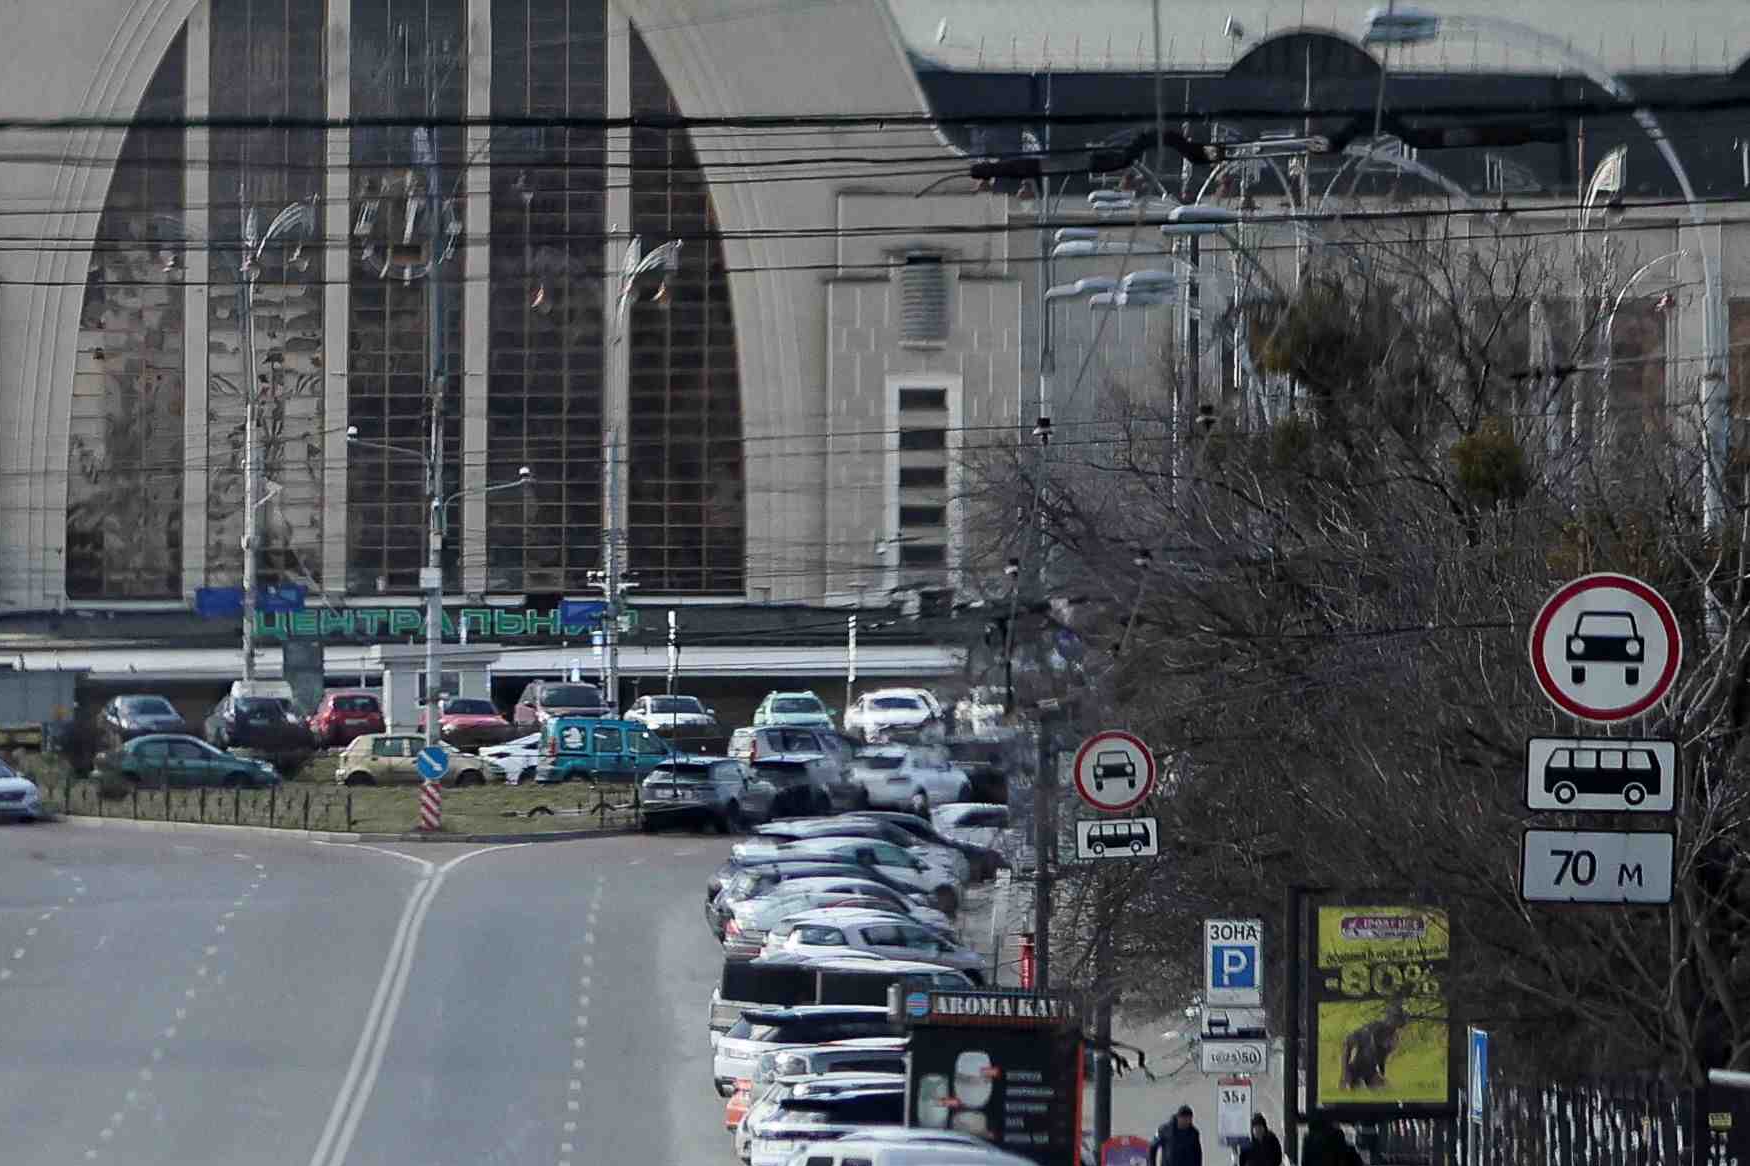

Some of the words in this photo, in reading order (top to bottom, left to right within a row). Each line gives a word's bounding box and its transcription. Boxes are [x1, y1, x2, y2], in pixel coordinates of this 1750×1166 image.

[250, 606, 640, 639] ЦЕНТРАЛЬН
[1550, 849, 1597, 886] 70
[1210, 924, 1258, 941] ЗОНА
[937, 996, 1012, 1016] AROMA
